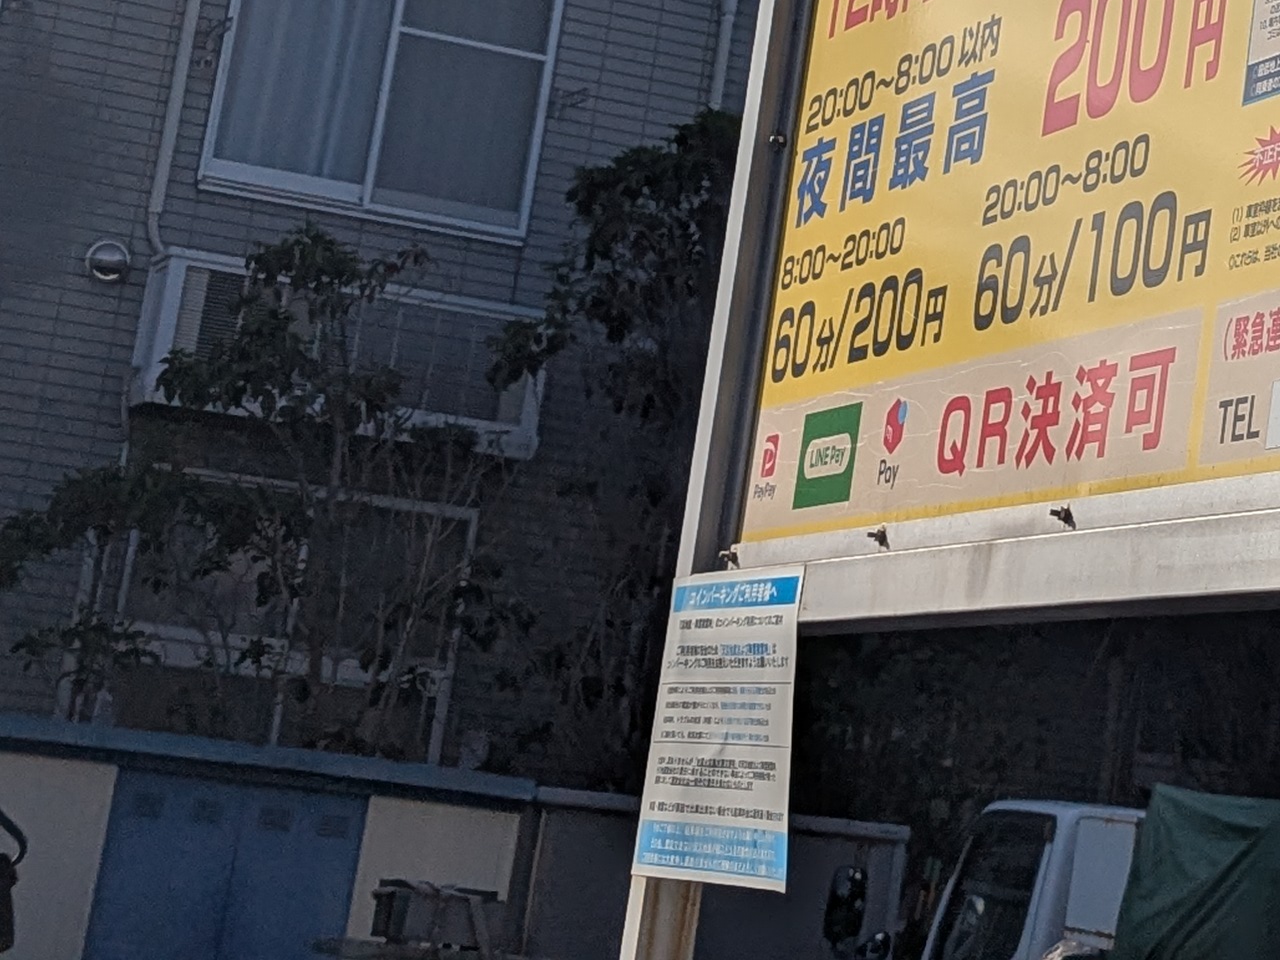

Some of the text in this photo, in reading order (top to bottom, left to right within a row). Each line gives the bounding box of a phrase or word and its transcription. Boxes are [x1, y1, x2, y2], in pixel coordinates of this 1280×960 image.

[794, 69, 996, 228] 夜間最高
[936, 346, 1177, 477] QR決済可
[1219, 394, 1260, 444] TEL
[809, 445, 846, 468] LINE Pay
[877, 459, 899, 490] Pay
[753, 482, 777, 500] PayPay
